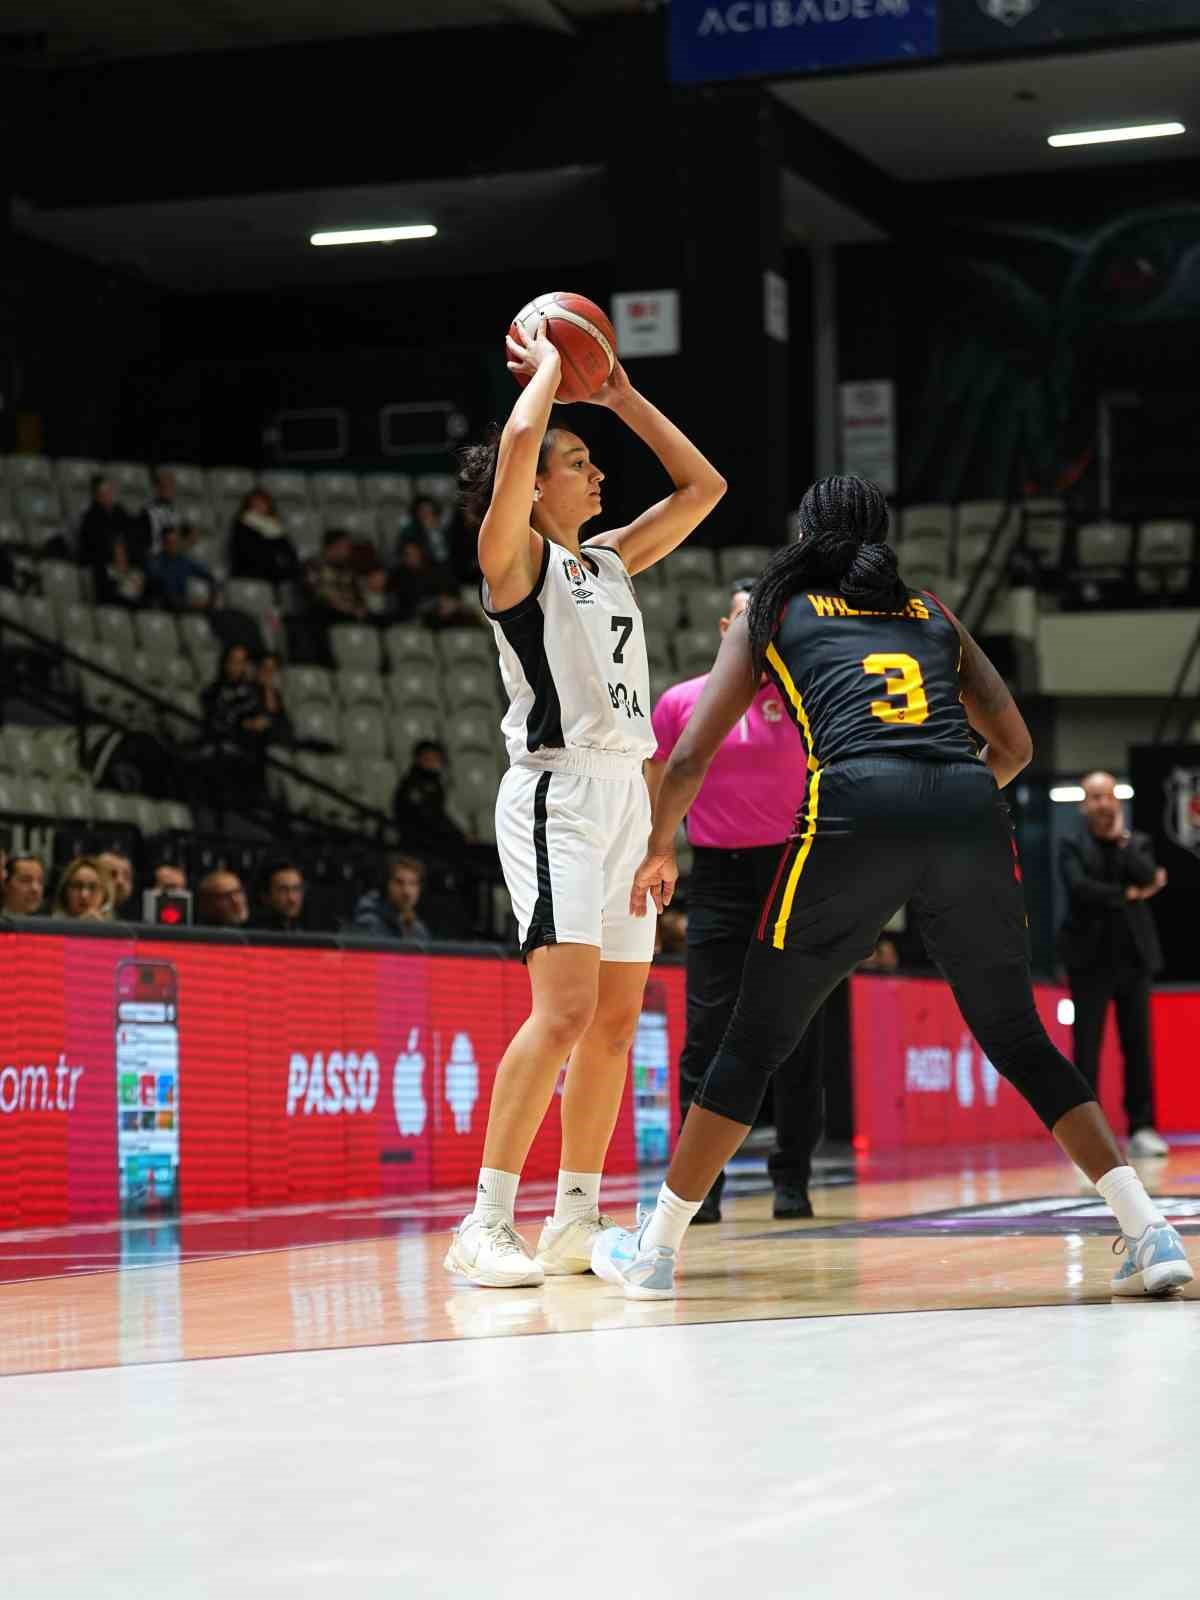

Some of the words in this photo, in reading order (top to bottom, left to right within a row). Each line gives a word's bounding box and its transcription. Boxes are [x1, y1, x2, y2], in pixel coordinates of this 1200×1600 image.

[697, 0, 910, 36] ACIBADEM
[806, 593, 929, 619] WILS
[610, 615, 633, 664] 7
[862, 652, 930, 725] 3
[286, 1050, 380, 1117] PASSO
